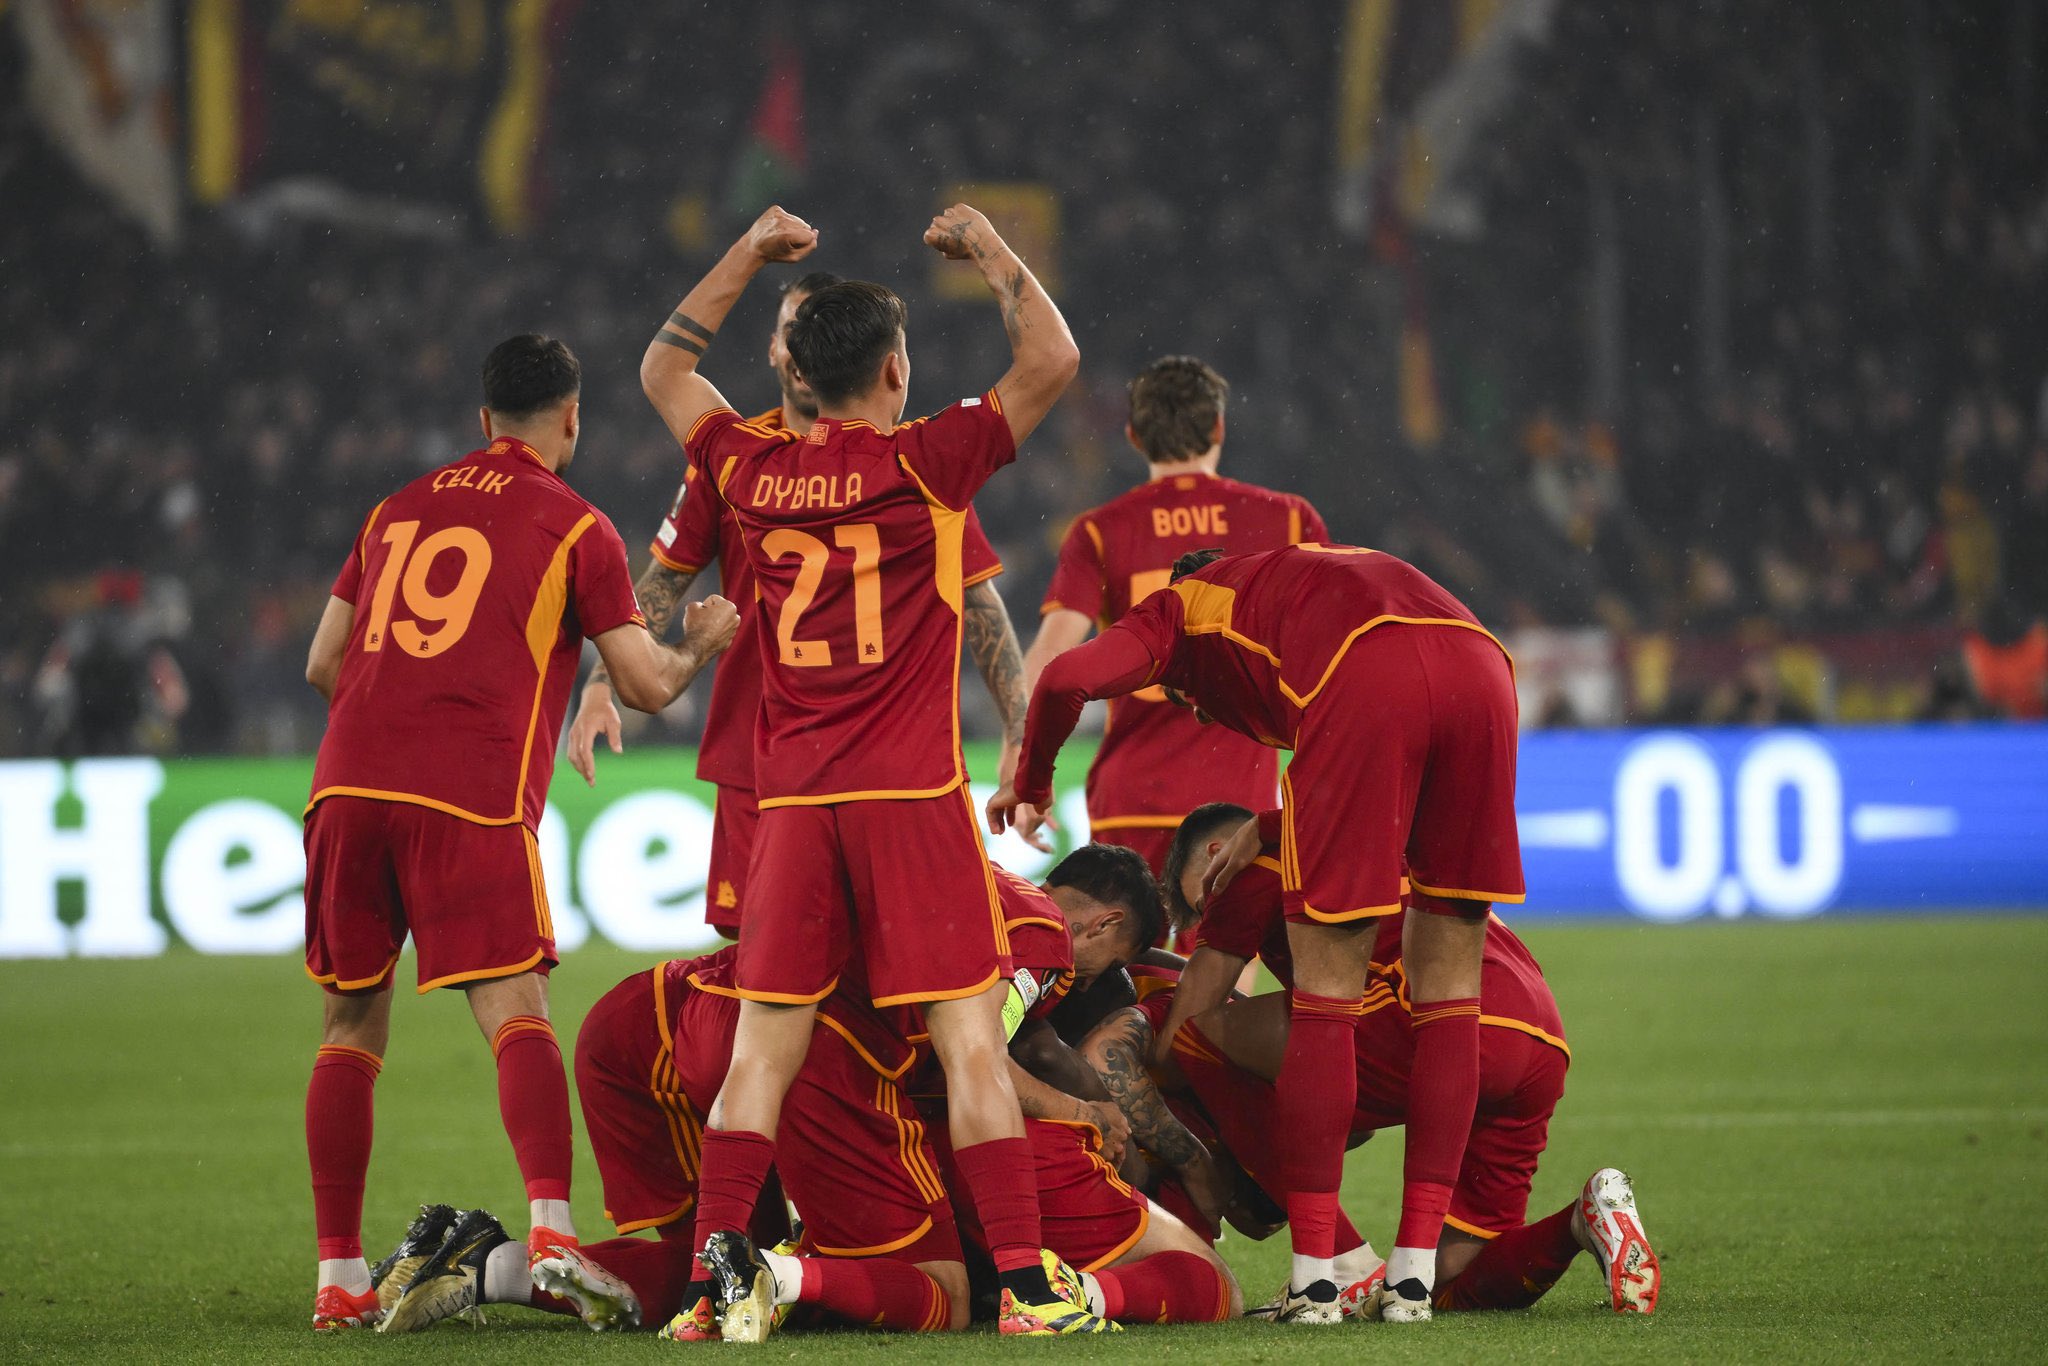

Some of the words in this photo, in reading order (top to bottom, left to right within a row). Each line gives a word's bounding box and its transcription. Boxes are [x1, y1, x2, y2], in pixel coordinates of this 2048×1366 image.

[431, 466, 514, 494] ÇELIK
[751, 473, 862, 509] DYBALA
[1152, 504, 1229, 537] BOVE
[364, 520, 492, 658] 19
[761, 523, 884, 666] 21
[1614, 731, 1843, 923] 0.0
